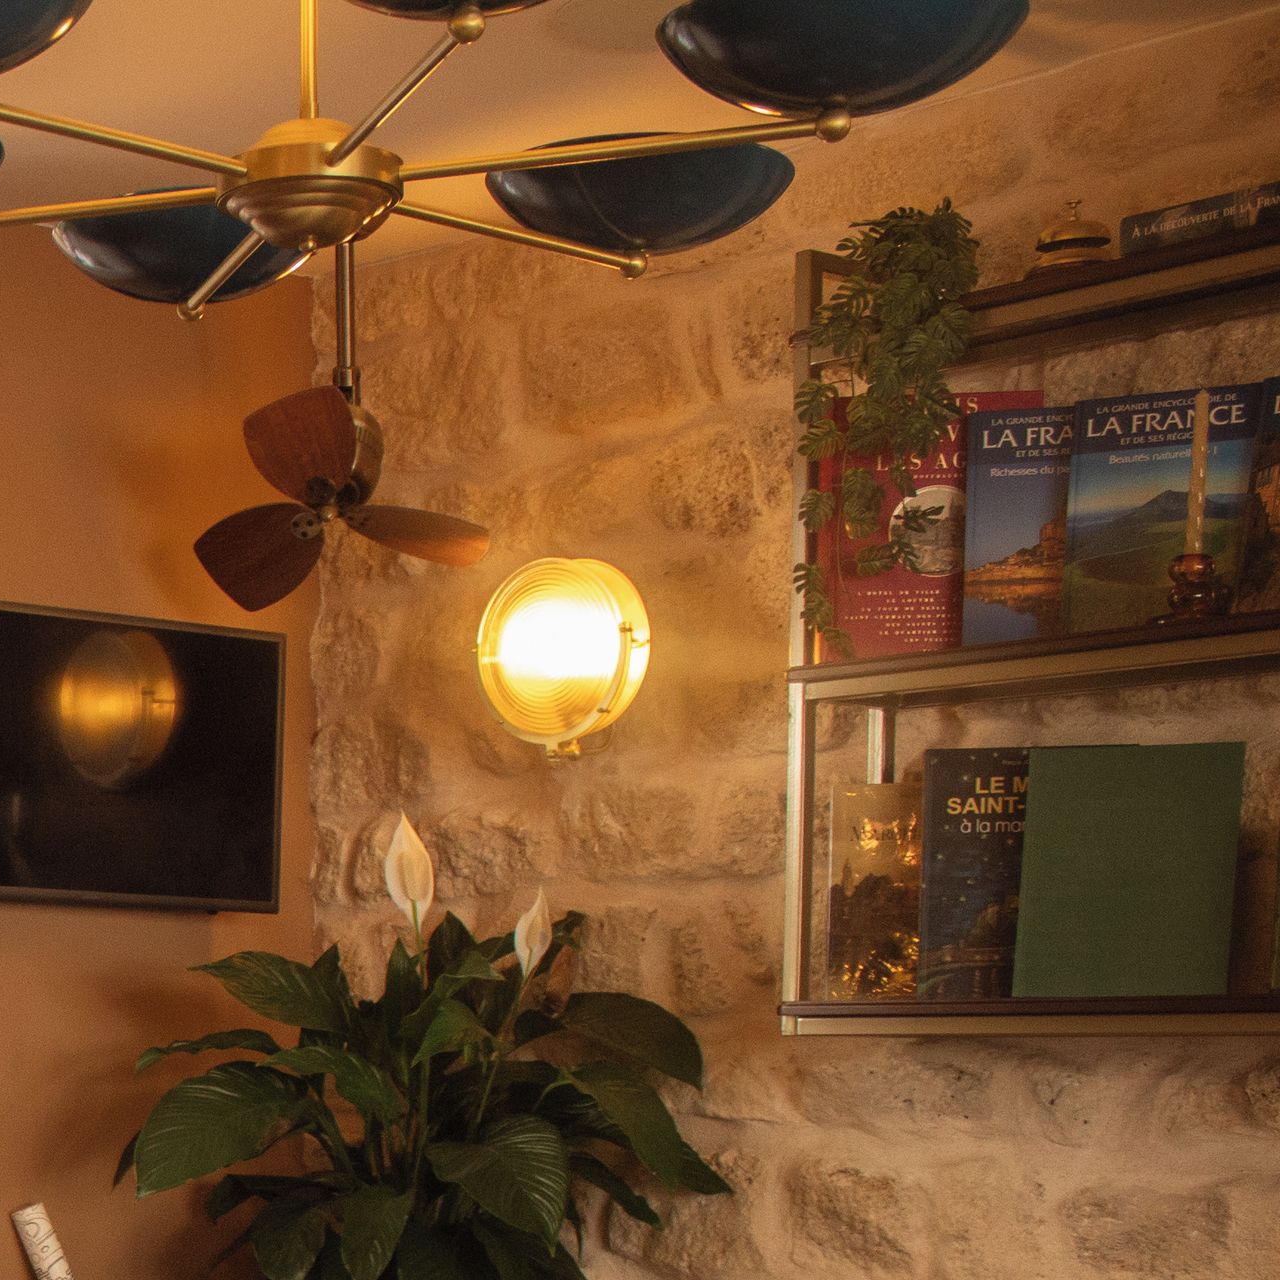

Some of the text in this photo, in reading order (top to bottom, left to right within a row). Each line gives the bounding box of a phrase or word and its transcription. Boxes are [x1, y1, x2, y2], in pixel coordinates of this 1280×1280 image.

[1087, 417, 1123, 438] LA
[983, 429, 1018, 449] LA
[975, 776, 1005, 794] LE
[947, 796, 1025, 815] SAINT-
[960, 818, 972, 833] à
[976, 818, 991, 833] la
